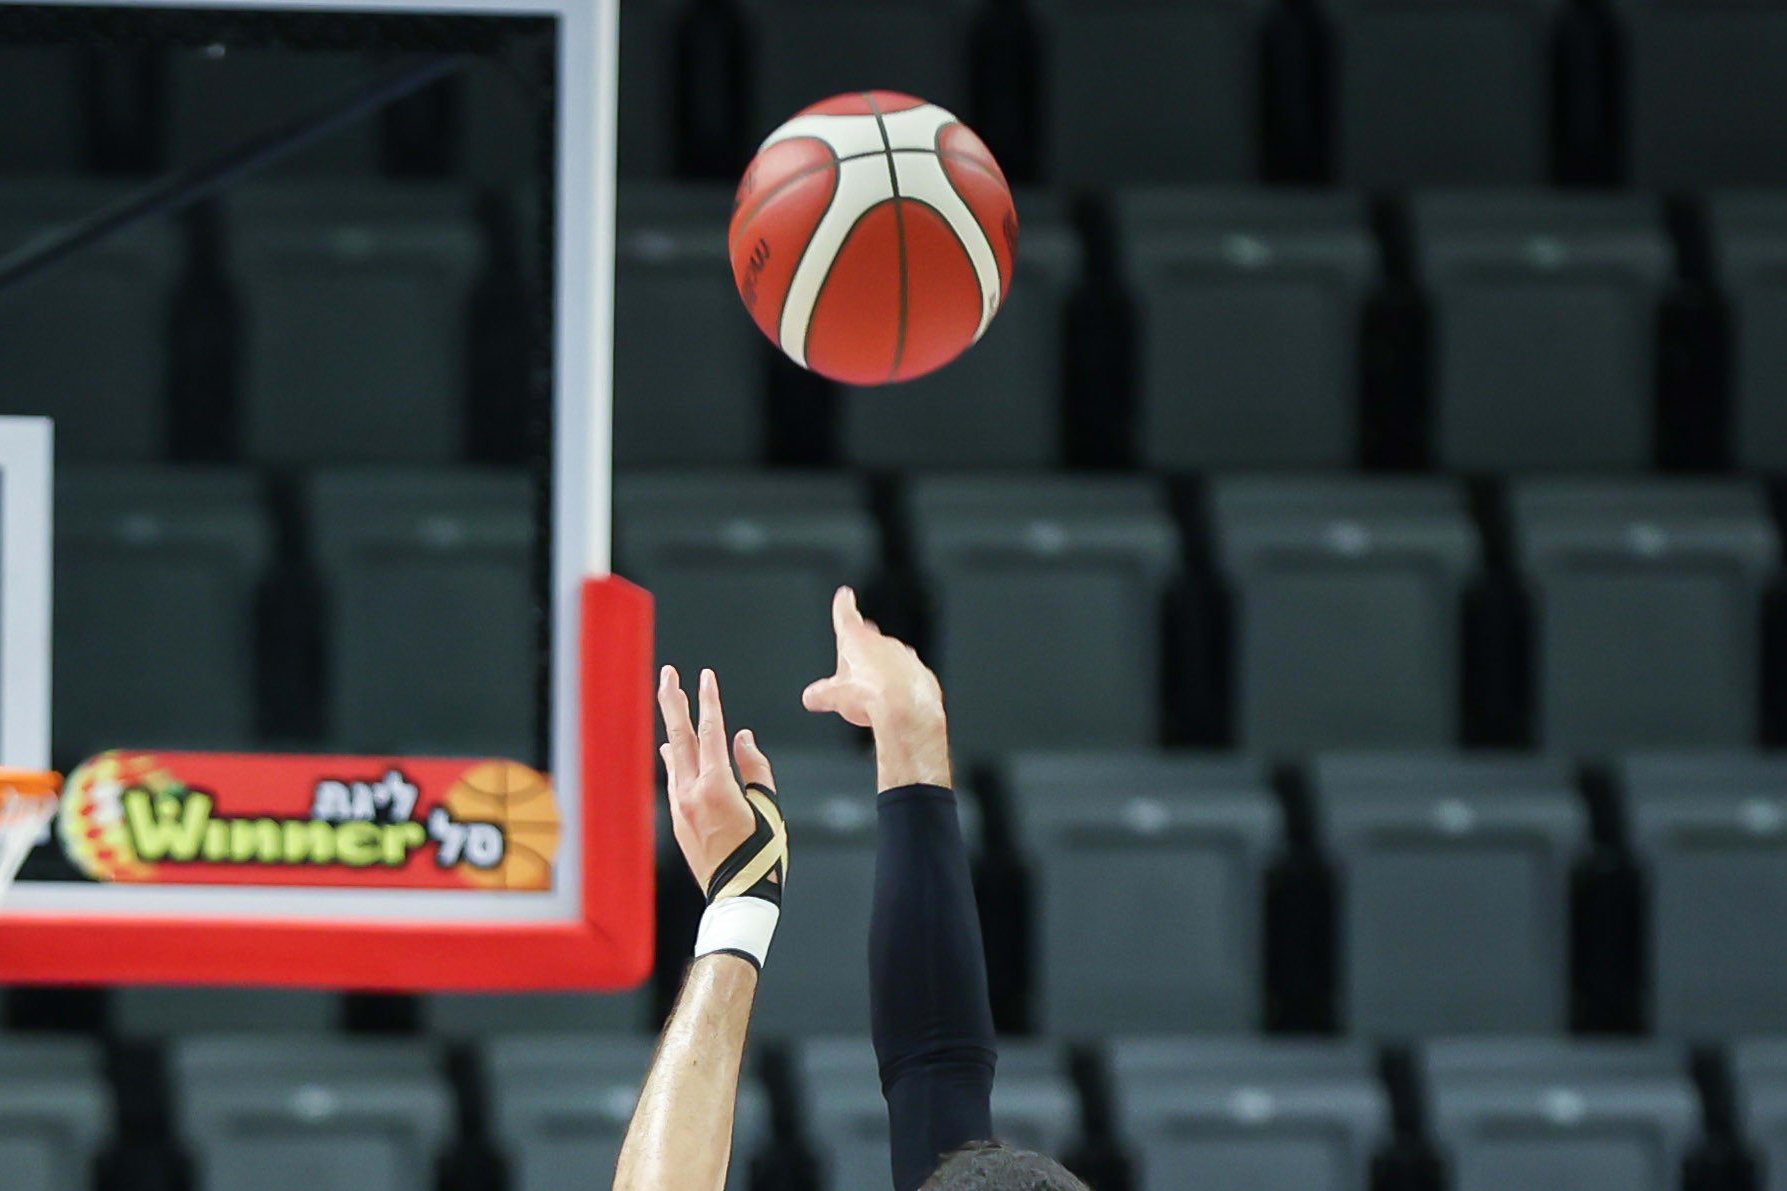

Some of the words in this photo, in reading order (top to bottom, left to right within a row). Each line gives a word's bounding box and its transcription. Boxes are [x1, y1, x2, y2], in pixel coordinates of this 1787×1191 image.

[124, 789, 425, 866] Winner
[428, 808, 504, 868] סל
[312, 770, 418, 822] ליגת
